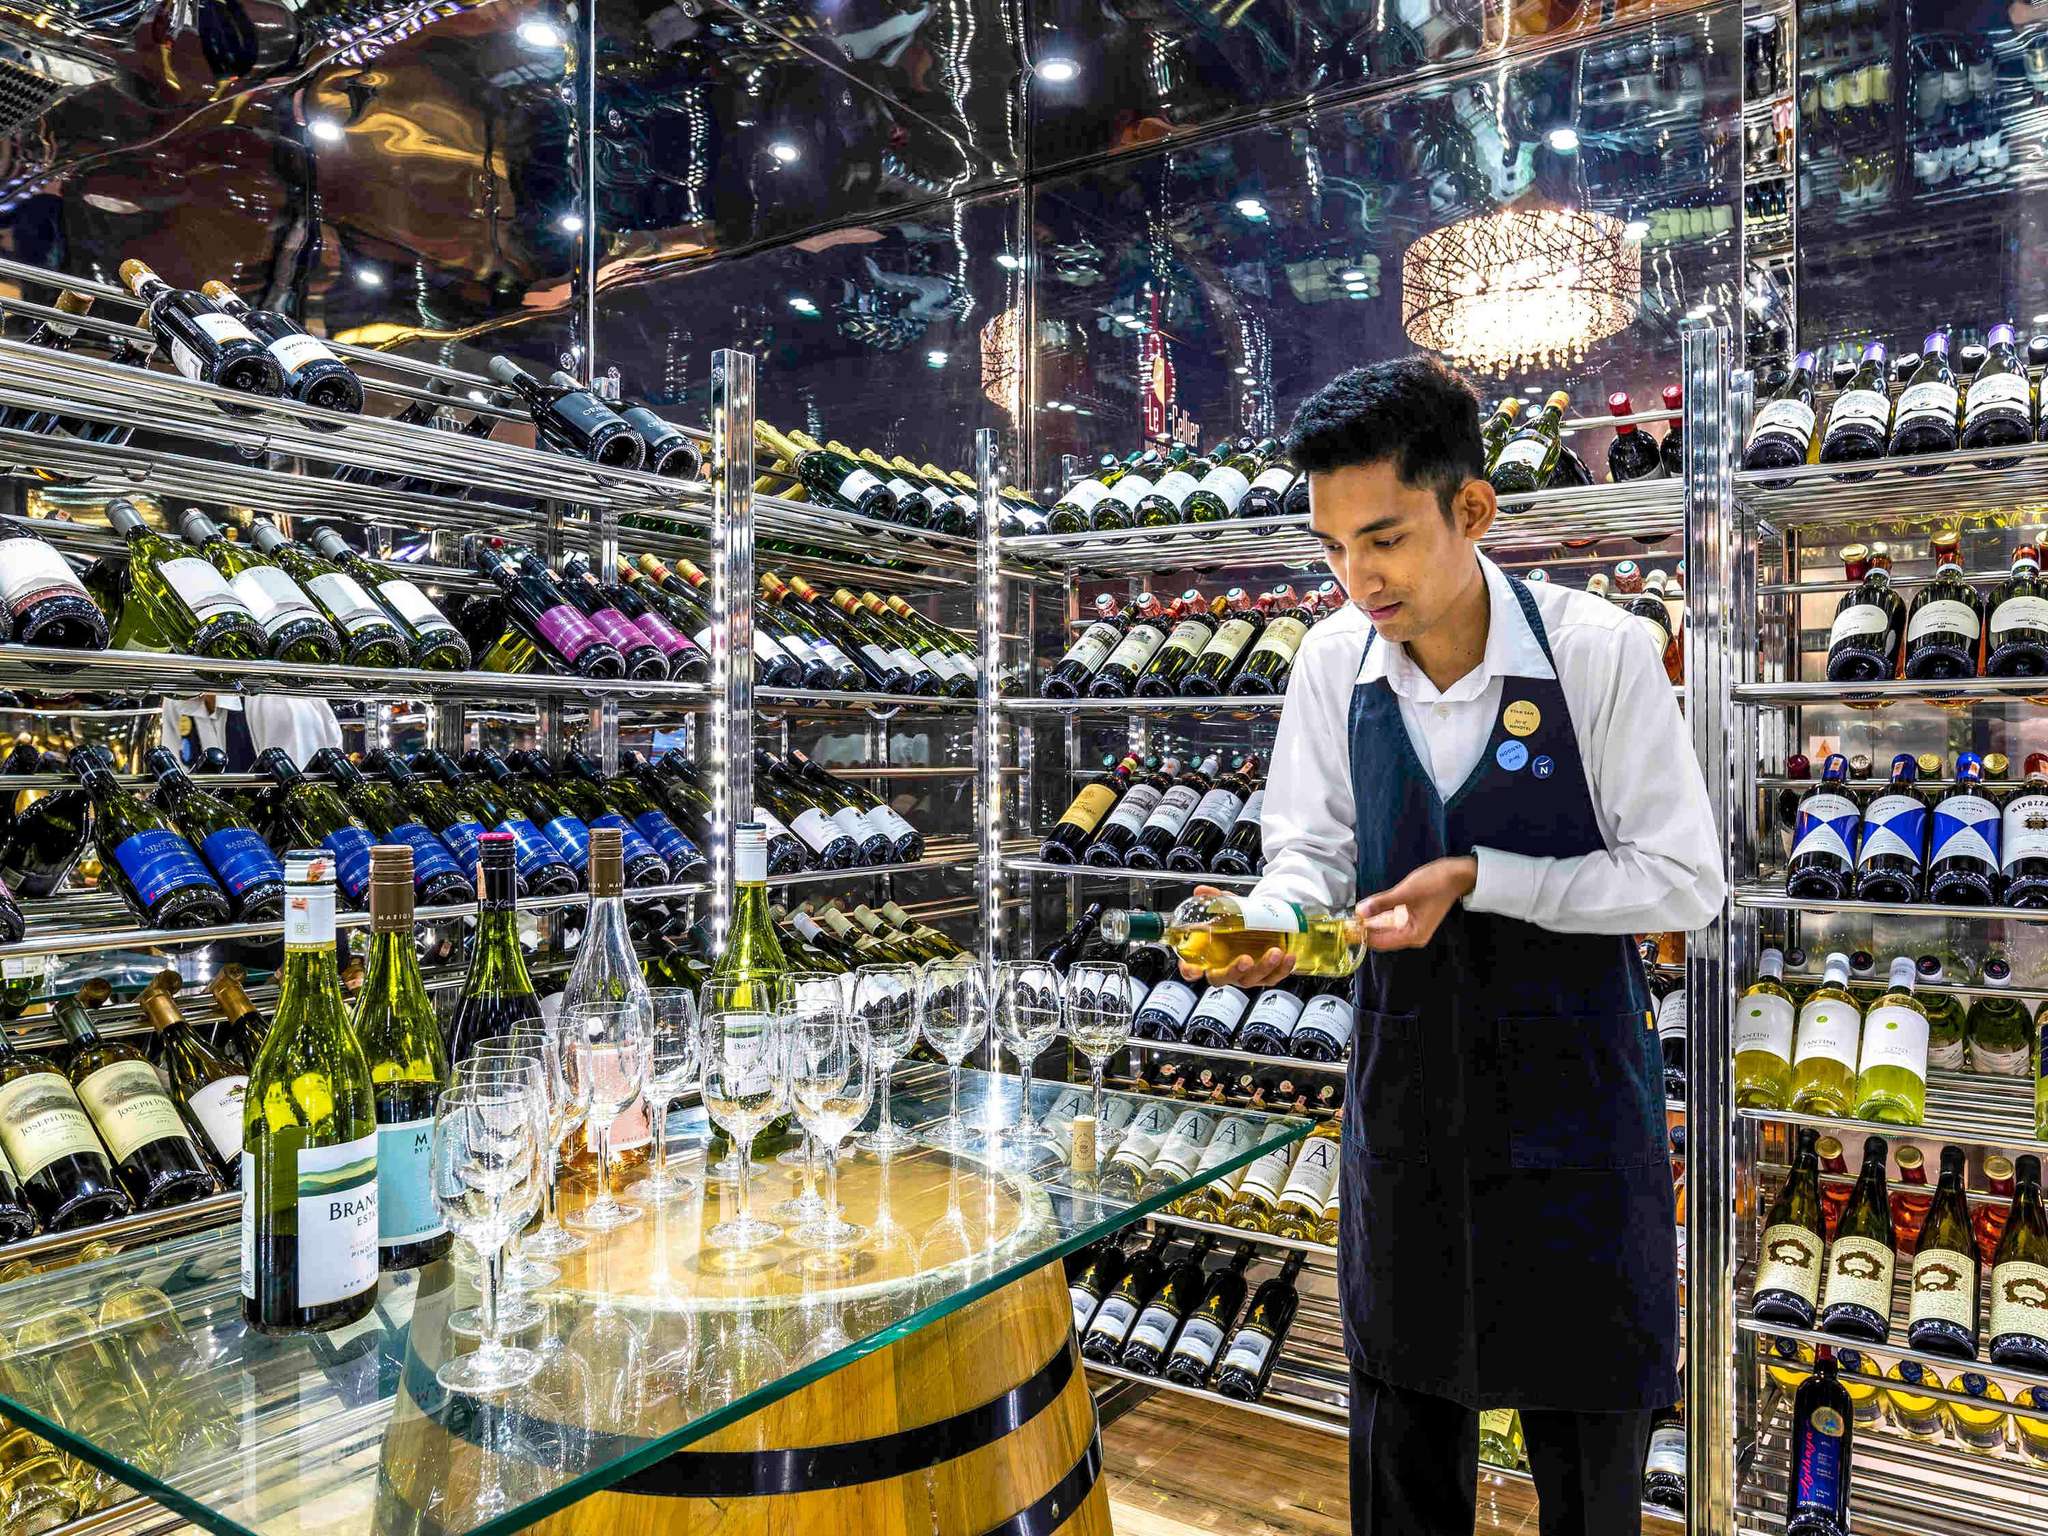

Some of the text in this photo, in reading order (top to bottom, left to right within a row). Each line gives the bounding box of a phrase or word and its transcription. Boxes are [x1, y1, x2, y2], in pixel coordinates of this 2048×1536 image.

[1148, 393, 1200, 449] Le Cellier
[1540, 766, 1548, 774] N
[117, 1097, 152, 1119] JOSEPH
[21, 1115, 60, 1138] JOSEPH
[1138, 1108, 1159, 1133] A
[1178, 1115, 1200, 1143] A
[415, 1132, 428, 1146] M
[1216, 1122, 1237, 1146] A
[1305, 1143, 1328, 1170] A
